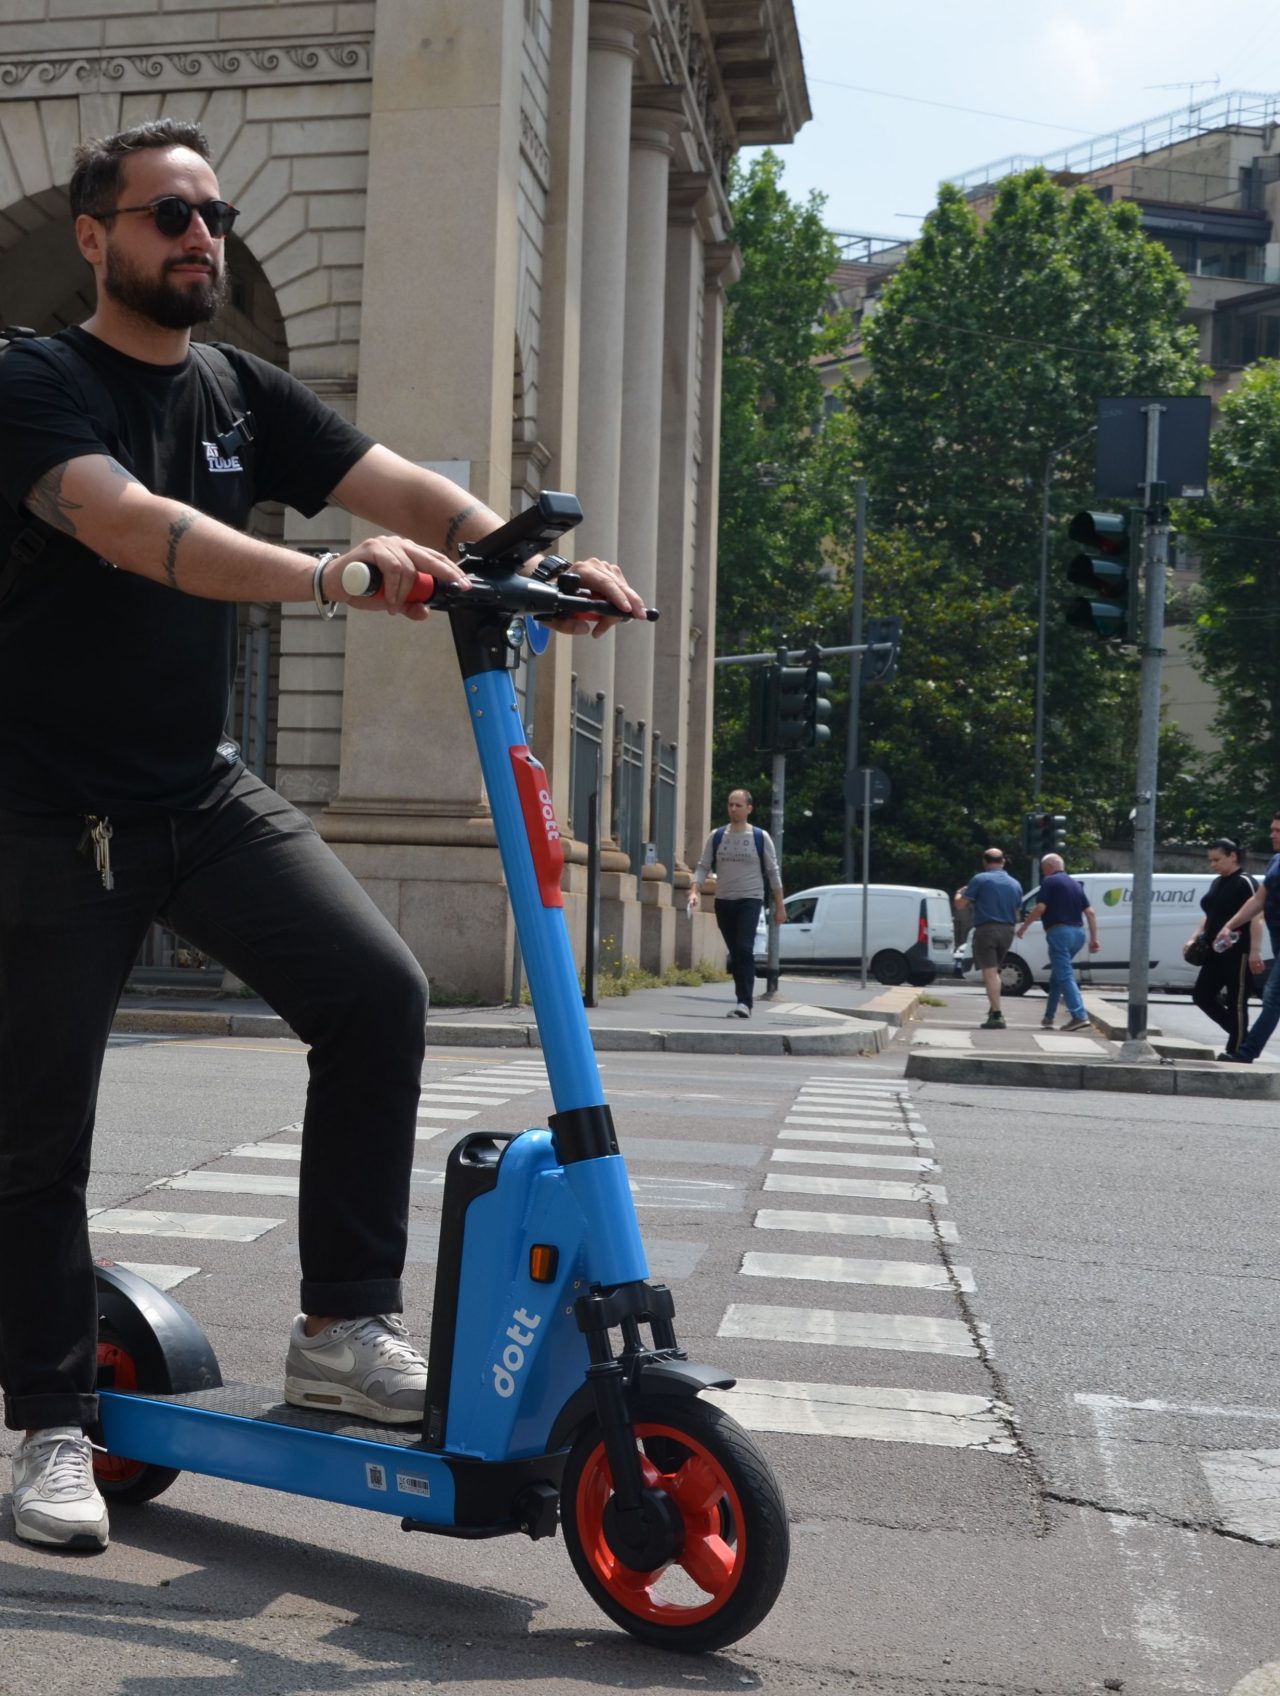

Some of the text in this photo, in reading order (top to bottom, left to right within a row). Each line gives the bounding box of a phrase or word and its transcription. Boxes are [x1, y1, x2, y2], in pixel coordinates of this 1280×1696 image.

[208, 456, 241, 469] TUDE
[538, 789, 559, 841] dott
[492, 1307, 541, 1398] dott
